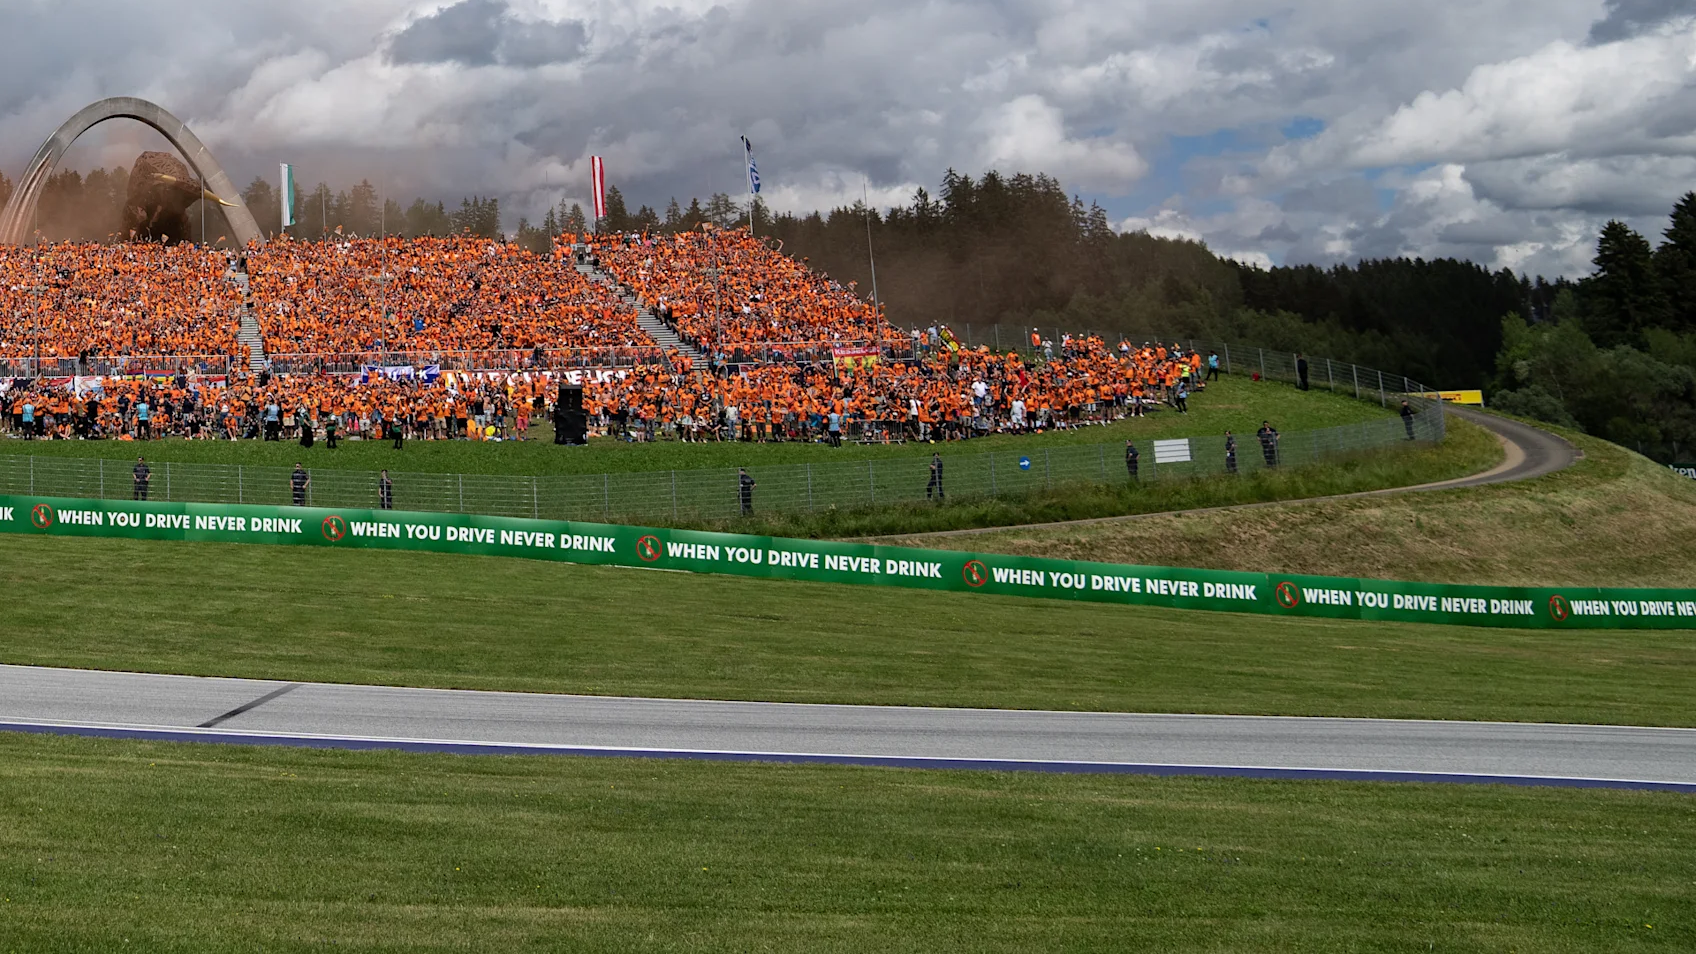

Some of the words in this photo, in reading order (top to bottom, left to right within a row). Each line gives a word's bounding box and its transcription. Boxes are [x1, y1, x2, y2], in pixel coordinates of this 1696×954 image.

[57, 509, 103, 526] WHEN
[107, 511, 141, 528] YOU
[145, 513, 191, 529] DRIVE
[195, 515, 246, 531] NEVER
[250, 517, 303, 534] DRINK
[350, 521, 401, 538] WHEN
[404, 523, 441, 541] YOU
[446, 526, 495, 544] DRIVE
[500, 529, 555, 548] NEVER
[560, 533, 616, 553] DRINK
[666, 541, 720, 561] WHEN
[724, 546, 763, 564] YOU
[768, 549, 819, 569] DRIVE
[824, 554, 881, 574] NEVER
[886, 559, 942, 578] DRINK
[992, 567, 1045, 586] WHEN
[1048, 571, 1086, 590] YOU
[1091, 574, 1141, 593] DRIVE
[1145, 578, 1199, 597] NEVER
[1203, 582, 1257, 600] DRINK
[1302, 587, 1352, 606] WHEN
[1354, 591, 1389, 609] YOU
[1393, 593, 1437, 611] DRIVE
[1441, 597, 1487, 614] NEVER
[1490, 599, 1534, 615] DRINK
[1569, 600, 1610, 615] WHEN
[1611, 600, 1638, 616] YOU
[1639, 600, 1675, 616] DRIVE
